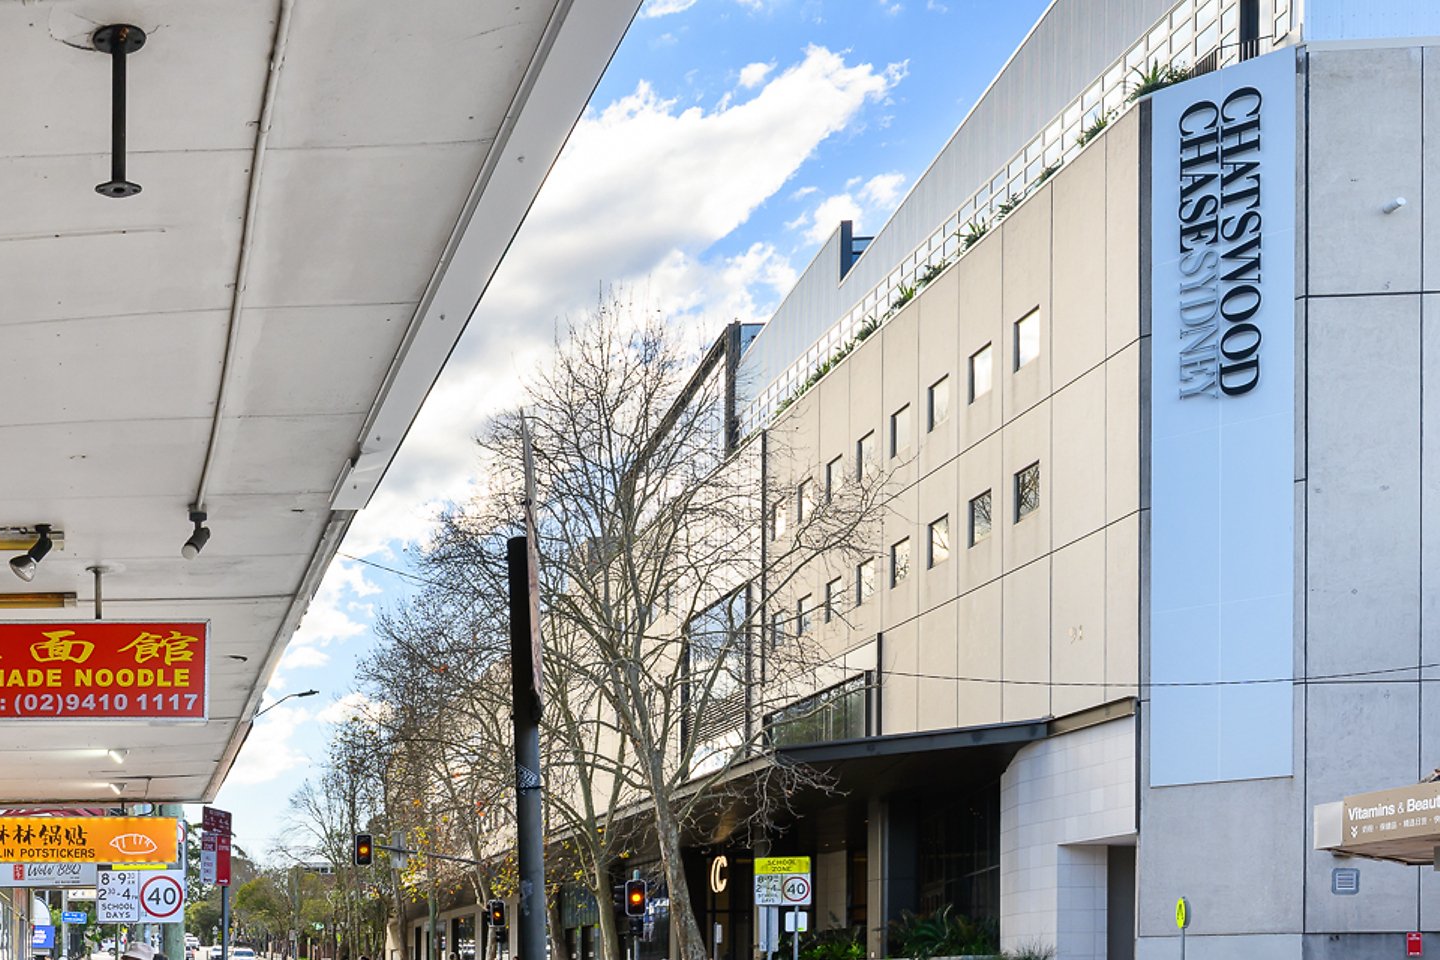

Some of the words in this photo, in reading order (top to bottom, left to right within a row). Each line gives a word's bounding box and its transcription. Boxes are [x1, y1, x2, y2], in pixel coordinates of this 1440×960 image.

[1178, 100, 1219, 254] CHASE
[1220, 86, 1262, 397] CHATSWOOD
[1178, 251, 1219, 401] SYDNEY
[74, 668, 190, 687] NOODLE
[14, 693, 128, 715] (02)9410
[136, 693, 198, 711] 1117
[1348, 803, 1395, 821] Vitamins
[1397, 802, 1405, 814] &
[20, 848, 96, 859] POTSTICKERS
[147, 887, 177, 906] 40
[786, 882, 806, 895] 40
[101, 903, 135, 911] SCHOOL
[105, 911, 131, 919] DAYS
